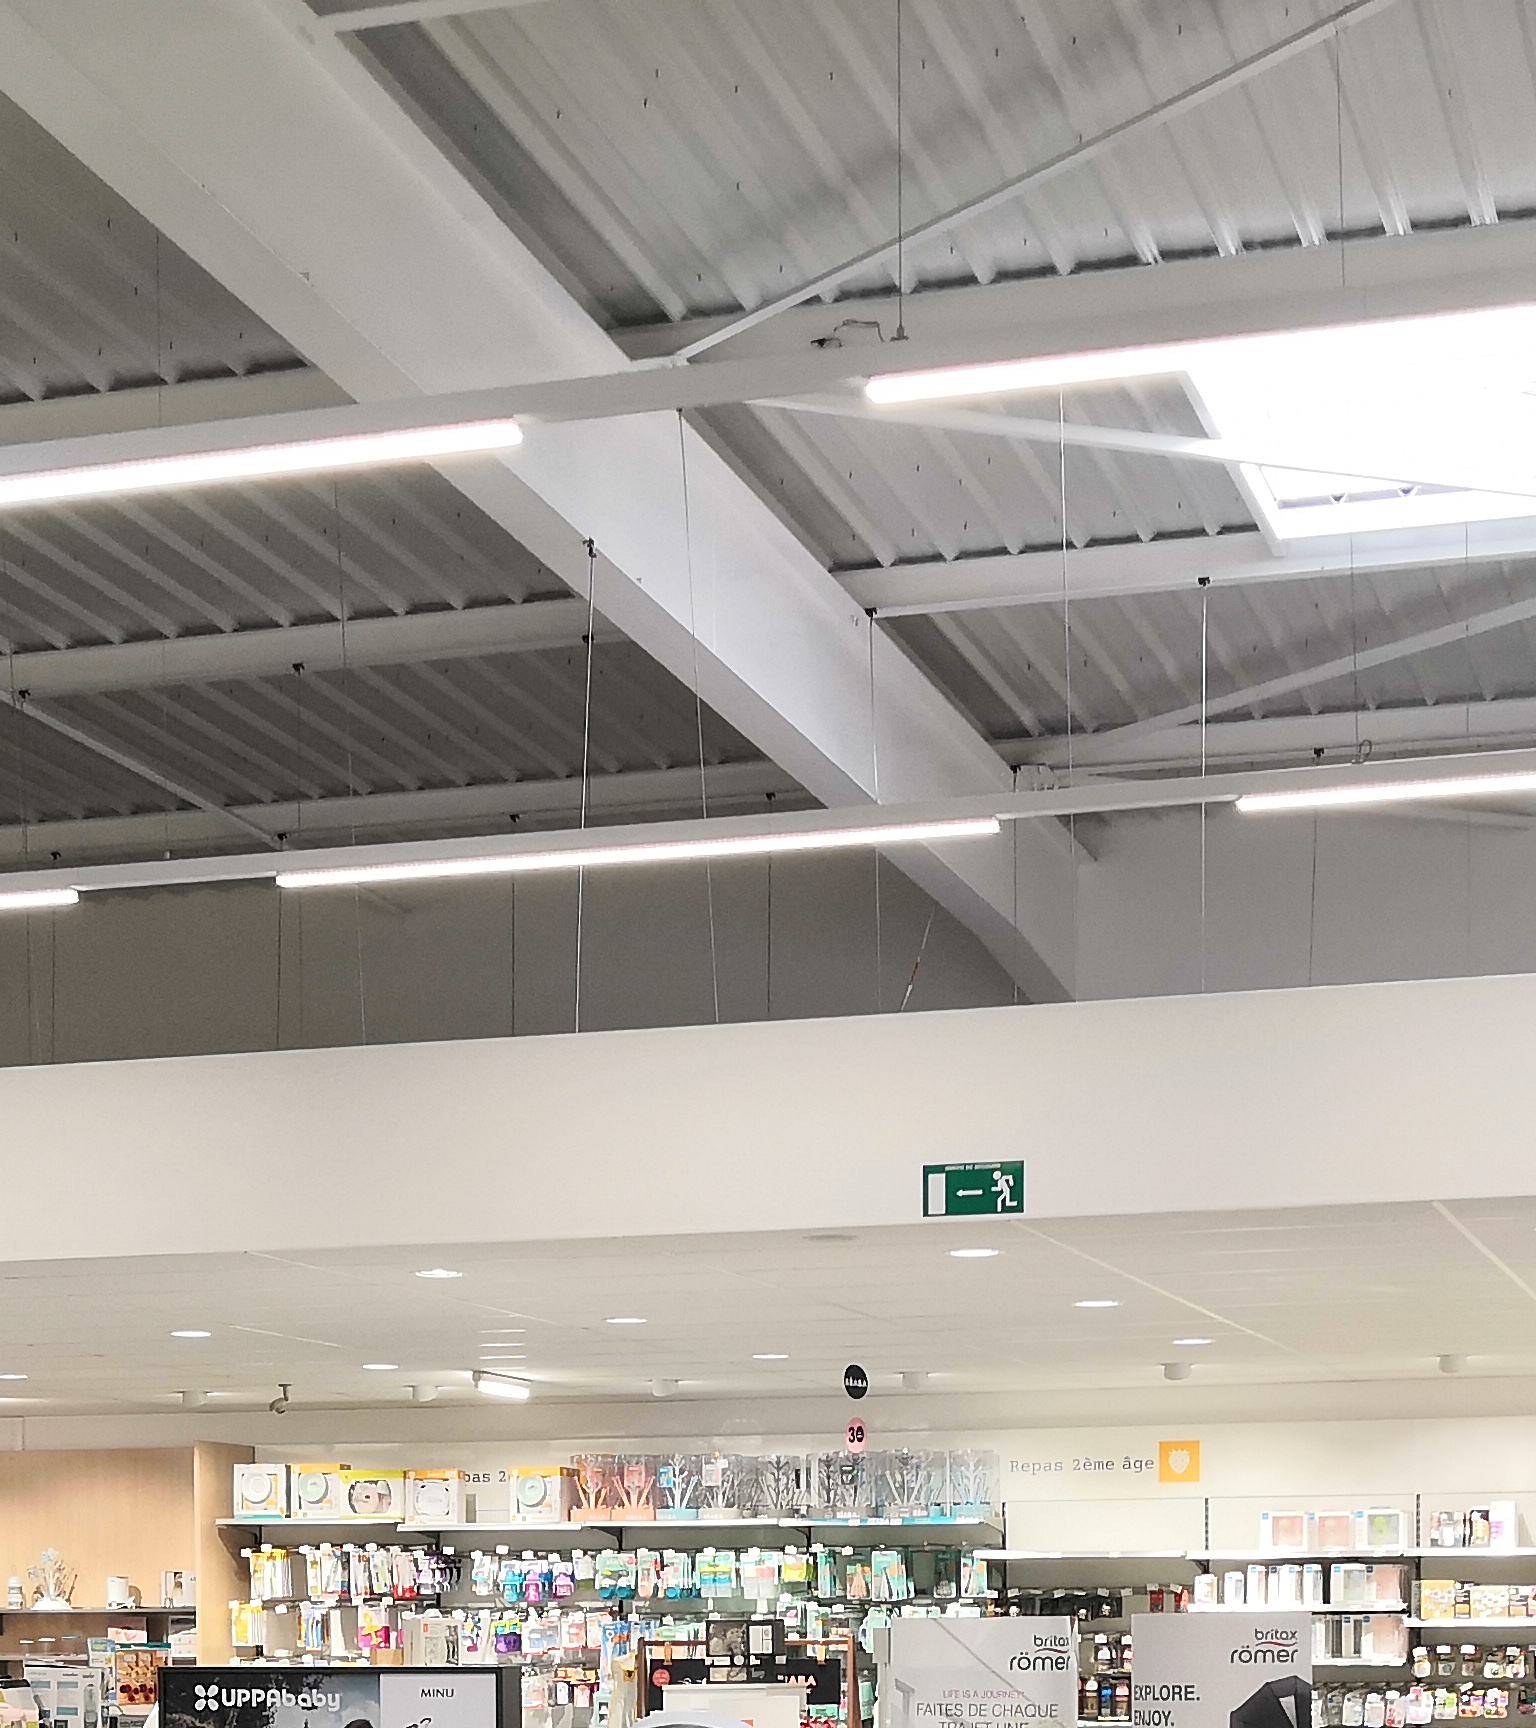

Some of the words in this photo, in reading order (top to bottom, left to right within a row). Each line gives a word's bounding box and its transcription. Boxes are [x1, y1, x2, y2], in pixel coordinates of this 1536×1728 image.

[1009, 1458, 1063, 1475] Repas
[1072, 1457, 1116, 1472] 2ème
[1122, 1455, 1155, 1475] âge
[1254, 1628, 1298, 1642] britax
[1009, 1652, 1072, 1671] römer
[1230, 1646, 1298, 1664] römer
[420, 1688, 455, 1698] MINU
[973, 1690, 979, 1698] A
[1134, 1684, 1200, 1702] EXPLORE.
[916, 1703, 964, 1717] FAITES
[968, 1703, 988, 1717] DE
[992, 1703, 1059, 1718] CHAQUE
[1134, 1709, 1175, 1728] ENJOY.
